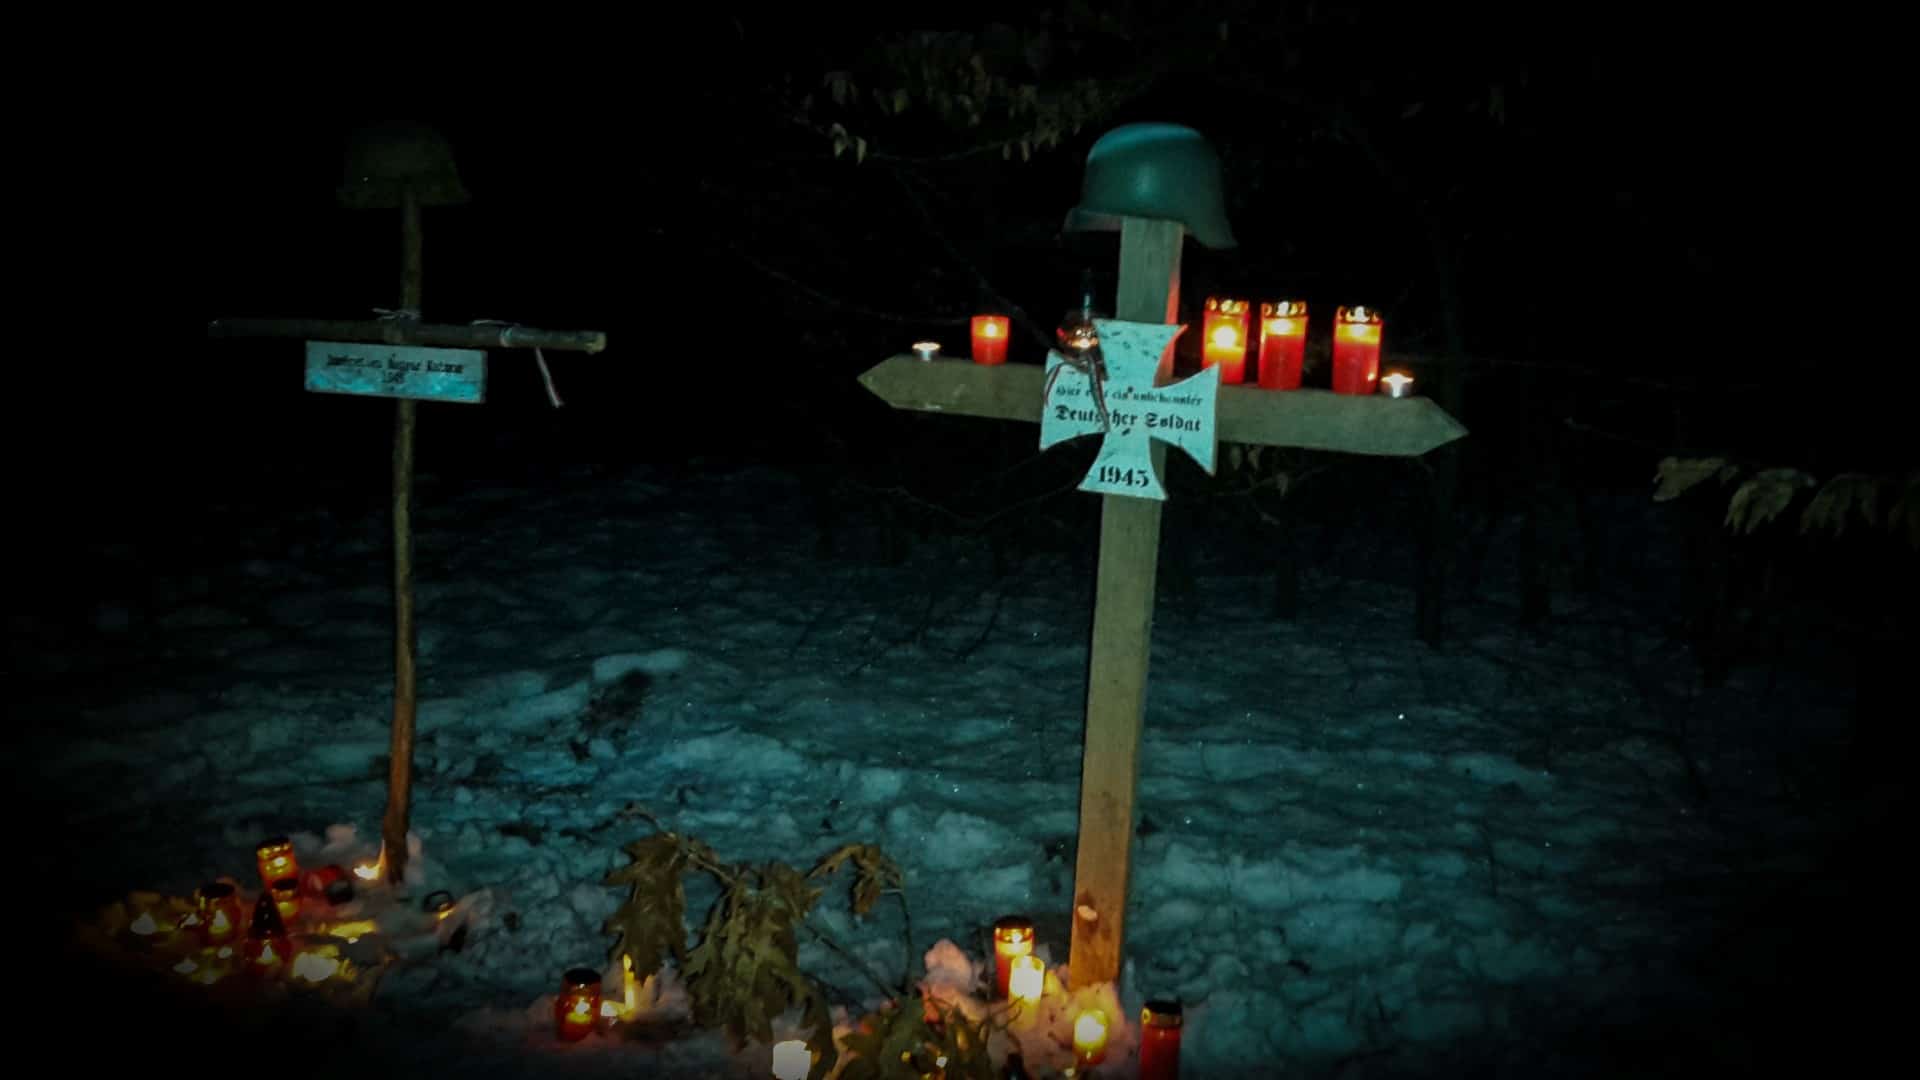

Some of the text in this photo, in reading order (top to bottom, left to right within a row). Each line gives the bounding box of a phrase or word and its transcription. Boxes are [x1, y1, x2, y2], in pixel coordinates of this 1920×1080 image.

[1055, 404, 1201, 432] Deutsher Soldat
[1098, 465, 1150, 488] 1945
